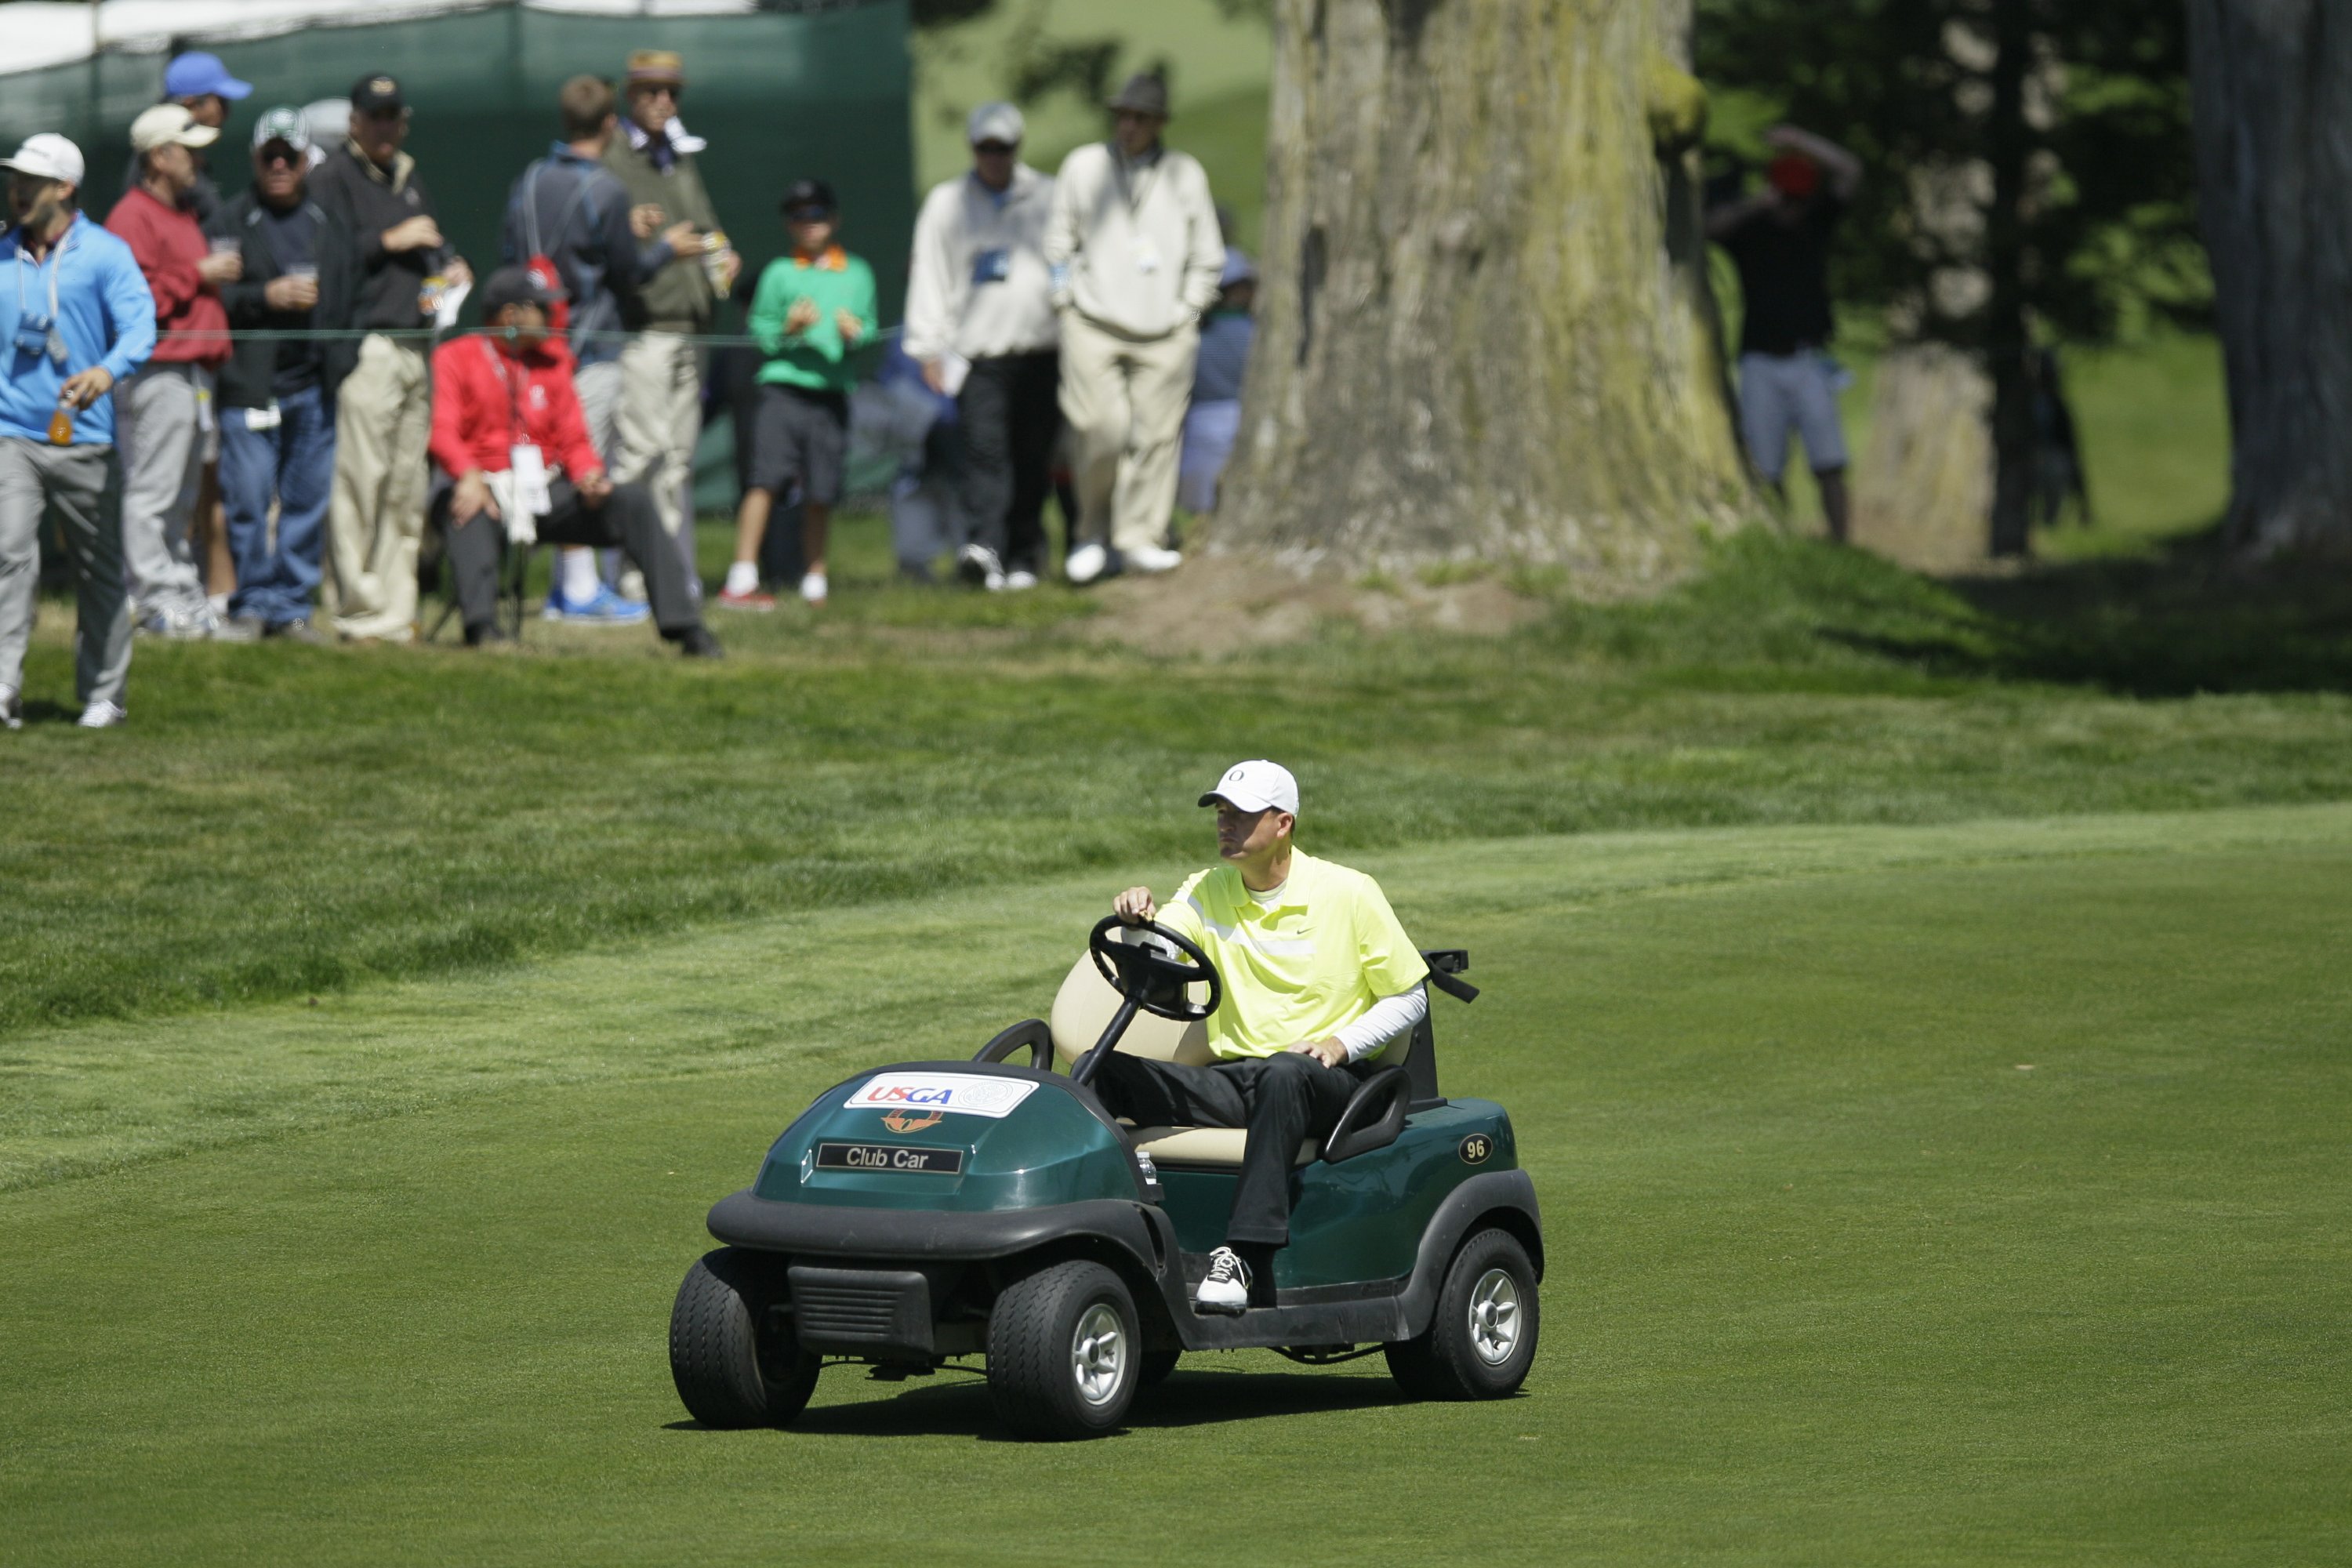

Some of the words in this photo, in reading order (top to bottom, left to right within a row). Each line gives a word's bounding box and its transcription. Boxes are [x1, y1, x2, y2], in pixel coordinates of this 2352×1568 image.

[867, 1087, 953, 1105] USGA
[847, 1147, 888, 1167] Club
[893, 1149, 929, 1169] Car
[1467, 1139, 1485, 1159] 96
